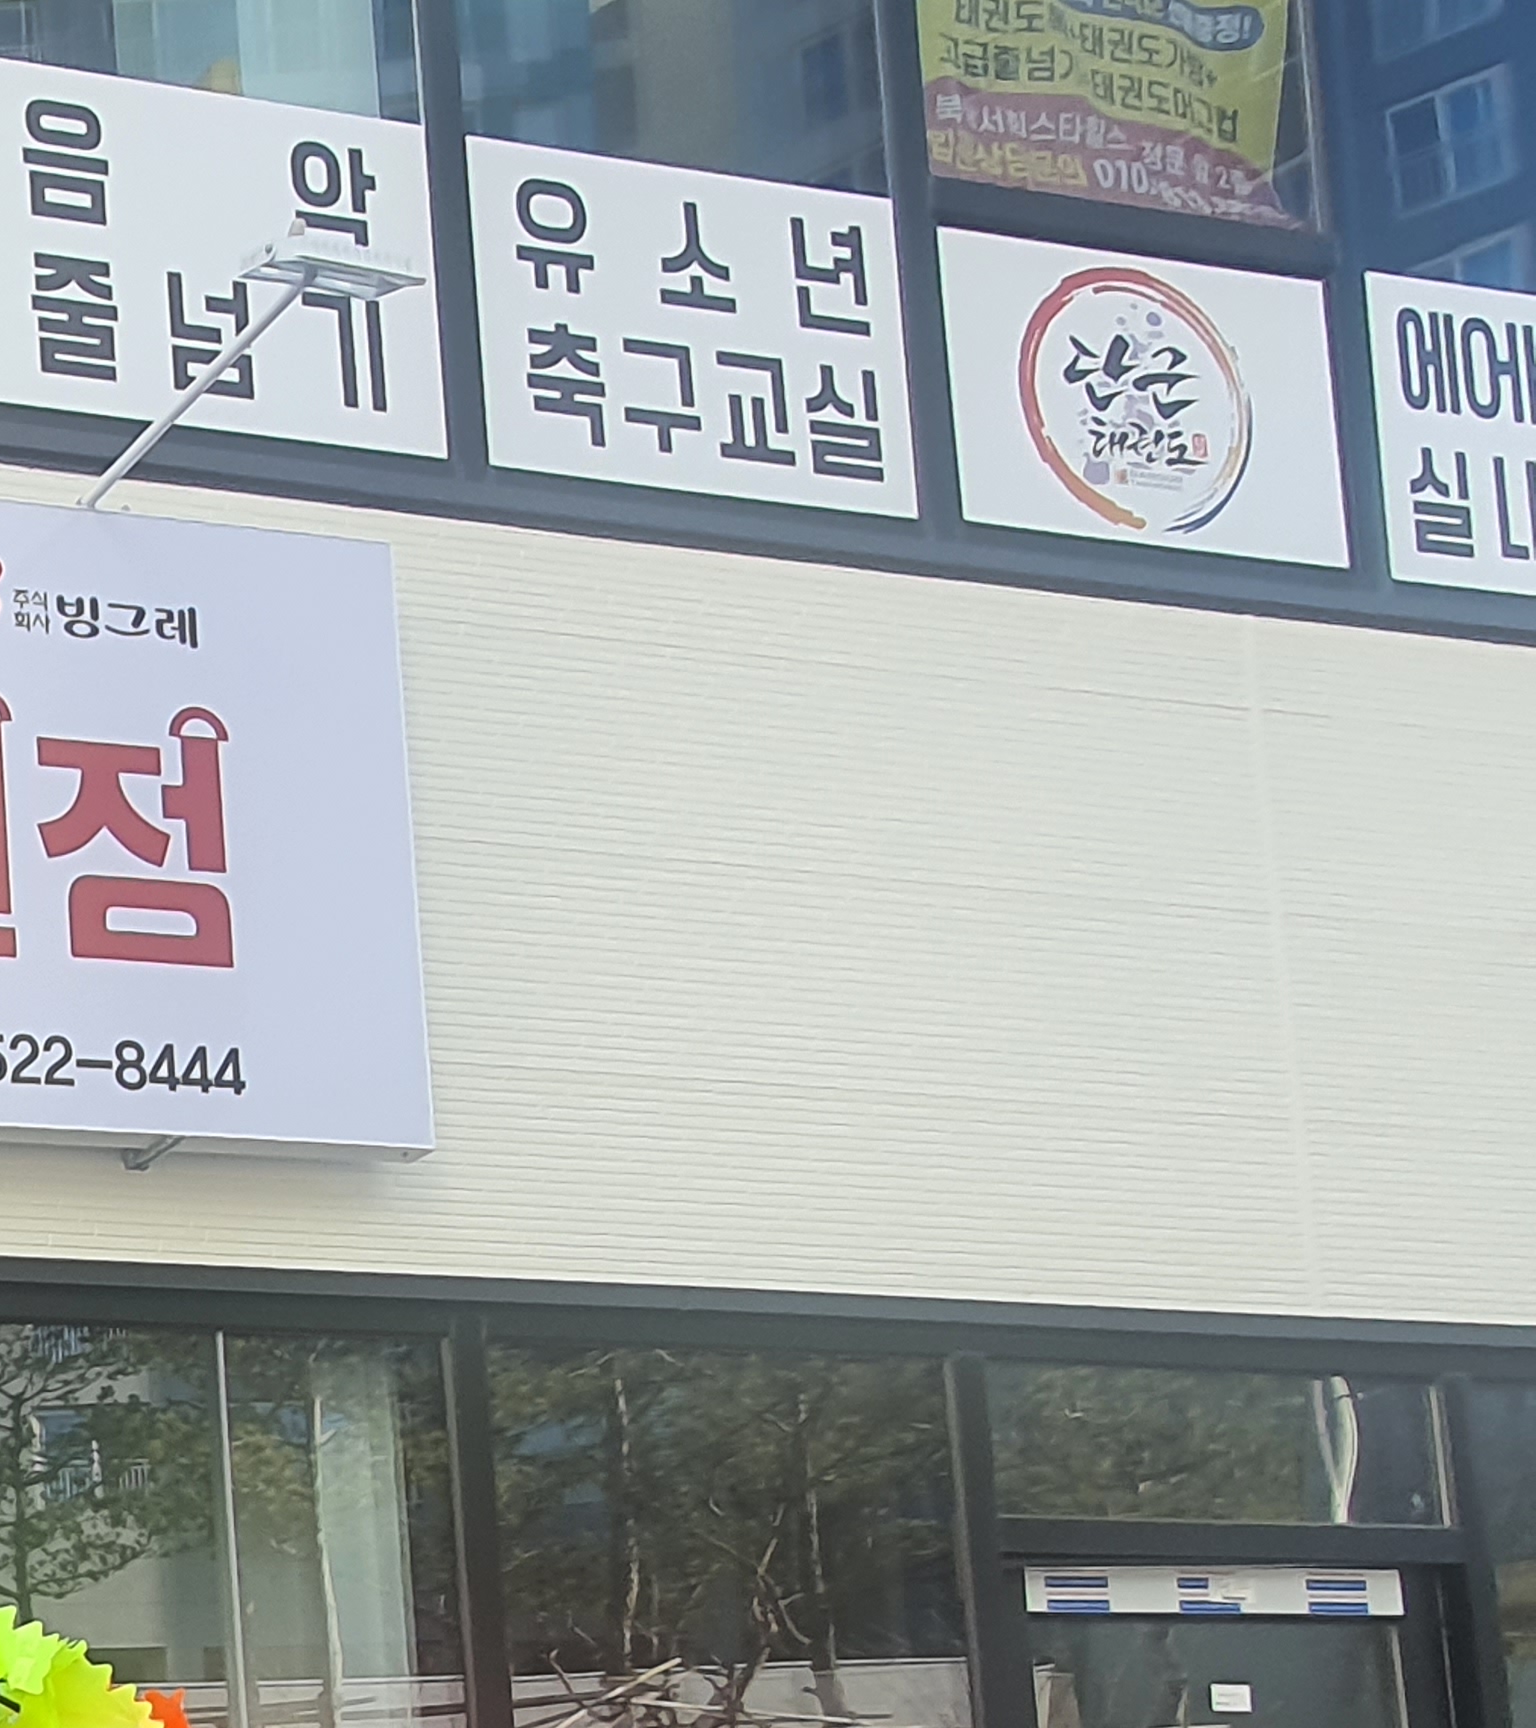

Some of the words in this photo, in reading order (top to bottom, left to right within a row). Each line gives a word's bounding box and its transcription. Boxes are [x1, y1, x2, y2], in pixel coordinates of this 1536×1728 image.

[527, 322, 885, 483] 축구교실
[1397, 307, 1536, 425] 에어
[55, 594, 199, 649] 빙그레
